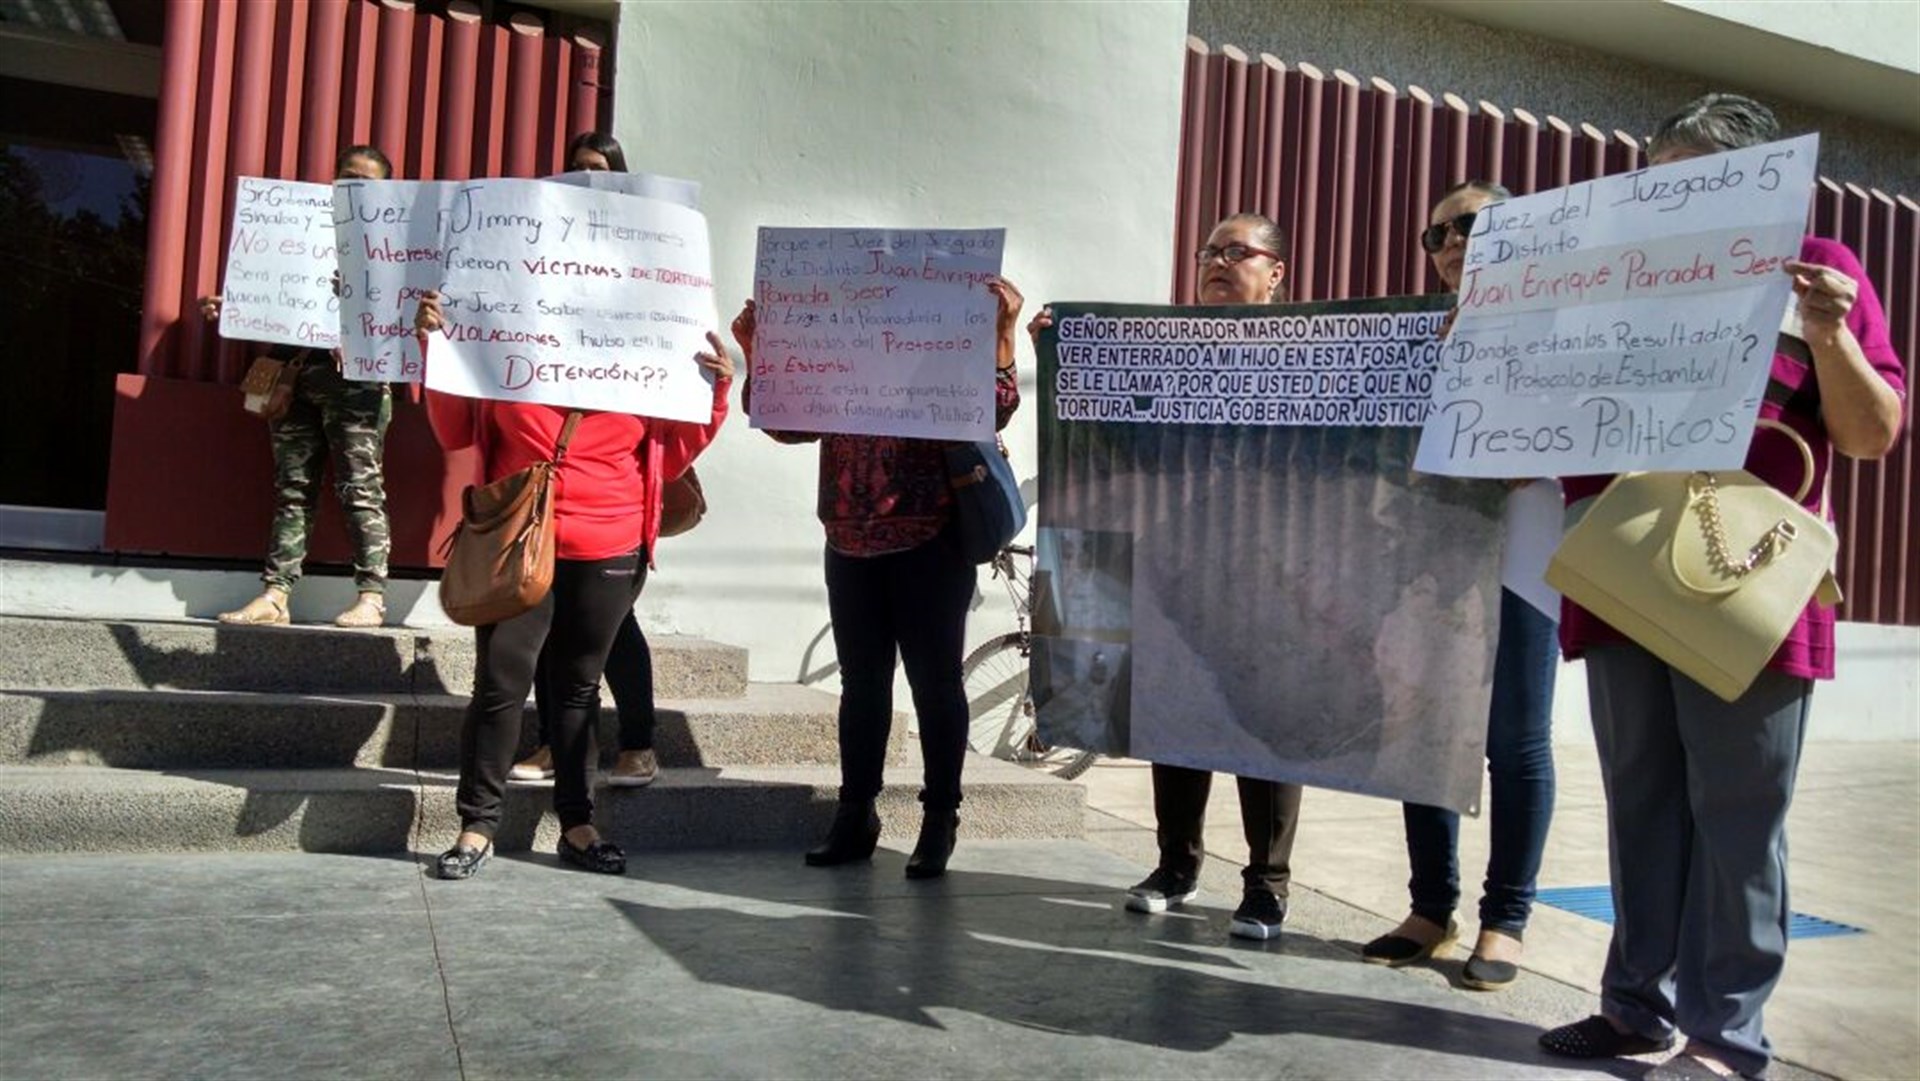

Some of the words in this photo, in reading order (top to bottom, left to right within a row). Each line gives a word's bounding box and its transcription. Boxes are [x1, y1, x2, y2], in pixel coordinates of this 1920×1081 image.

[335, 183, 413, 224] Juez
[1471, 202, 1535, 238] Juez
[1549, 184, 1592, 226] del
[1610, 159, 1744, 213] Juzgado
[304, 214, 315, 232] y
[451, 185, 543, 245] Jimmy
[561, 216, 576, 242] y
[231, 228, 269, 255] No
[279, 239, 306, 256] es
[1490, 231, 1580, 264] Distrito
[445, 246, 511, 271] fueron
[522, 256, 622, 280] VÍCTIMAS
[864, 249, 918, 279] Juan
[280, 273, 309, 289] por
[365, 269, 381, 302] le
[1460, 267, 1513, 308] Juan
[1521, 263, 1611, 300] Enrique
[1621, 249, 1715, 292] Parada
[466, 291, 523, 315] Juez
[759, 280, 830, 305] Parada
[758, 304, 778, 325] No
[964, 307, 988, 326] los
[1061, 316, 1118, 340] SEÑOR
[1123, 320, 1239, 340] PROCURADOR
[1242, 319, 1307, 339] MARCO
[1311, 317, 1392, 339] ANTONIO
[439, 322, 561, 348] VIOLACIONES
[577, 329, 625, 348] hubo
[882, 330, 972, 354] Protocolo
[1611, 318, 1743, 350] Resultados
[756, 357, 776, 376] de
[1060, 346, 1092, 365] VER
[1097, 347, 1199, 367] ENTERRADO
[1202, 347, 1213, 367] A
[1217, 347, 1236, 367] MI
[1240, 347, 1280, 367] HIJO
[1284, 347, 1307, 366] EN
[1312, 346, 1356, 367] ESTA
[1360, 345, 1408, 366] FOSA
[1059, 372, 1079, 391] SE
[1083, 373, 1104, 392] LE
[1108, 374, 1175, 393] LLAMA?
[1178, 374, 1213, 394] POR
[1217, 374, 1253, 394] QUE
[1257, 374, 1314, 394] USTED
[1318, 374, 1359, 394] DICE
[1364, 374, 1400, 396] QUE
[1405, 372, 1432, 394] NO
[1446, 365, 1473, 392] de
[1484, 365, 1501, 385] el
[1505, 358, 1587, 395] Protocolo
[1588, 362, 1611, 388] de
[1615, 354, 1719, 387] Estambul
[784, 380, 824, 396] Juez
[1059, 398, 1146, 419] TORTURA...
[1150, 401, 1224, 421] JUSTICIA
[1229, 401, 1350, 422] GOBERNADOR
[1440, 398, 1574, 460] Presos
[1579, 396, 1738, 459] Politicos
